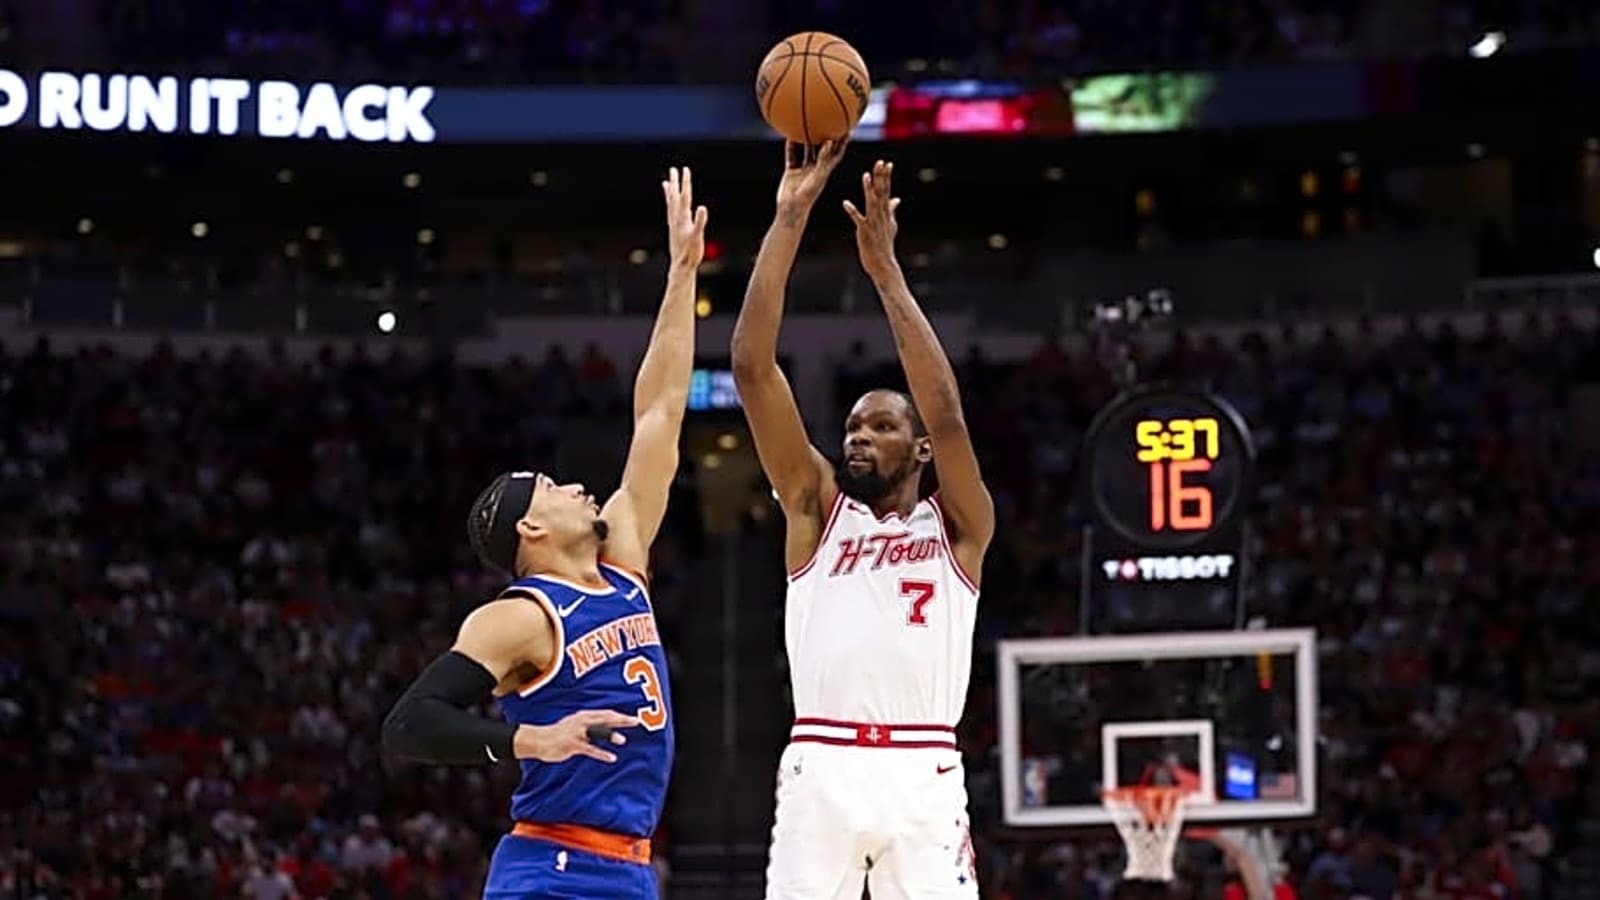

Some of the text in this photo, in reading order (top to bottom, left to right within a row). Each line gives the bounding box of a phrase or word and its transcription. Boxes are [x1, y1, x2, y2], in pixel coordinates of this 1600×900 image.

[39, 71, 178, 133] RUN
[189, 77, 251, 135] IT
[258, 80, 436, 142] BACK
[1136, 418, 1219, 462] 5:37
[1151, 459, 1212, 531] 16
[829, 531, 944, 577] H-Town
[1138, 555, 1233, 580] TISSOT
[900, 578, 936, 627] 7
[566, 621, 623, 679] NEW
[623, 656, 667, 731] 3
